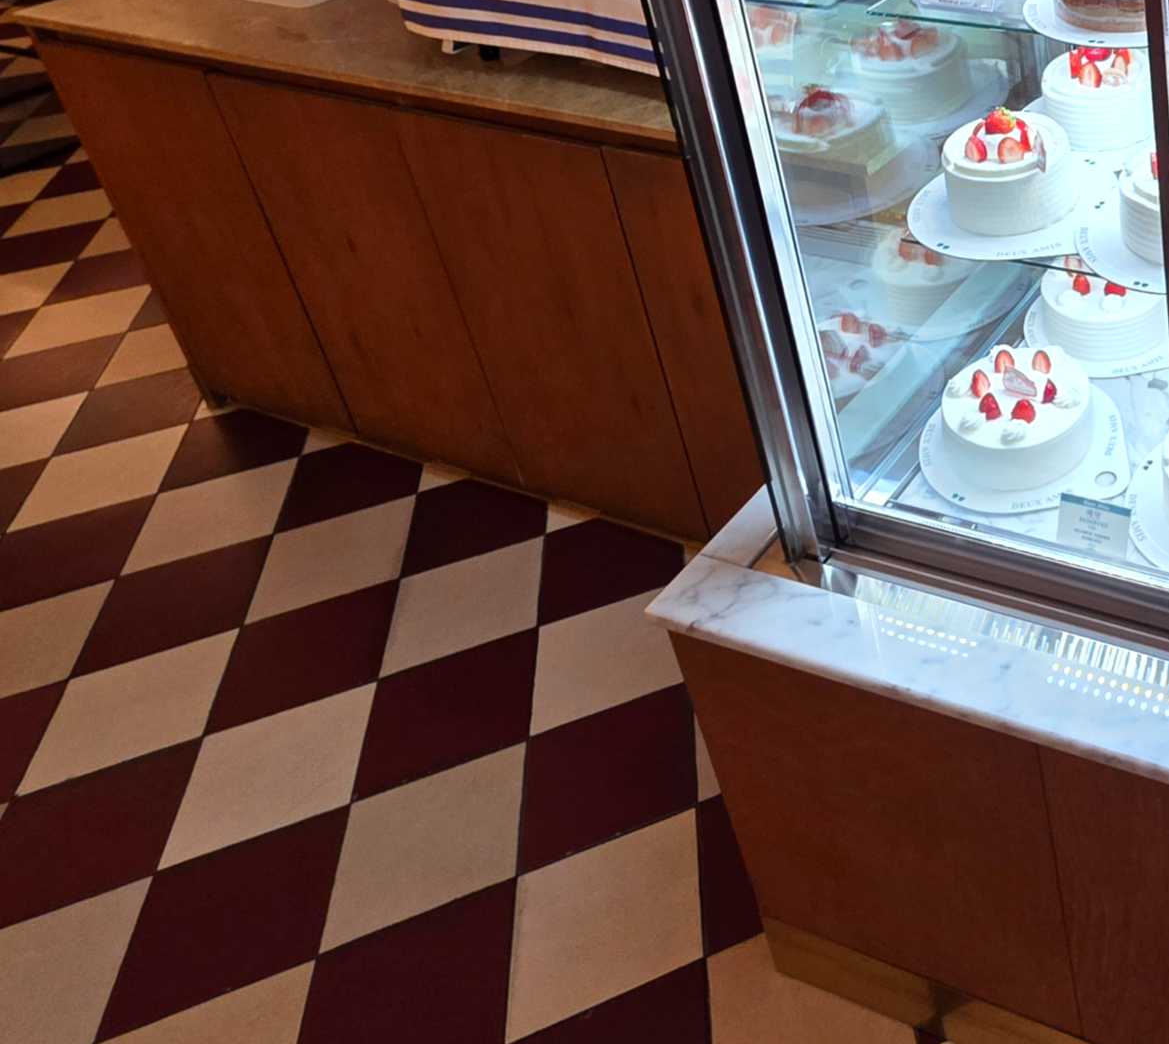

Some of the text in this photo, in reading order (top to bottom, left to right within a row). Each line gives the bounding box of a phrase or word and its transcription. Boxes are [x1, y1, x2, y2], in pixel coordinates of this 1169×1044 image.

[996, 241, 1063, 258] DEUX AMIS
[1112, 356, 1165, 375] DEUX AMIS
[1104, 414, 1119, 457] DEUX AMIS
[1011, 498, 1043, 511] DEUX
[1128, 493, 1148, 543] DEUX AMIS
